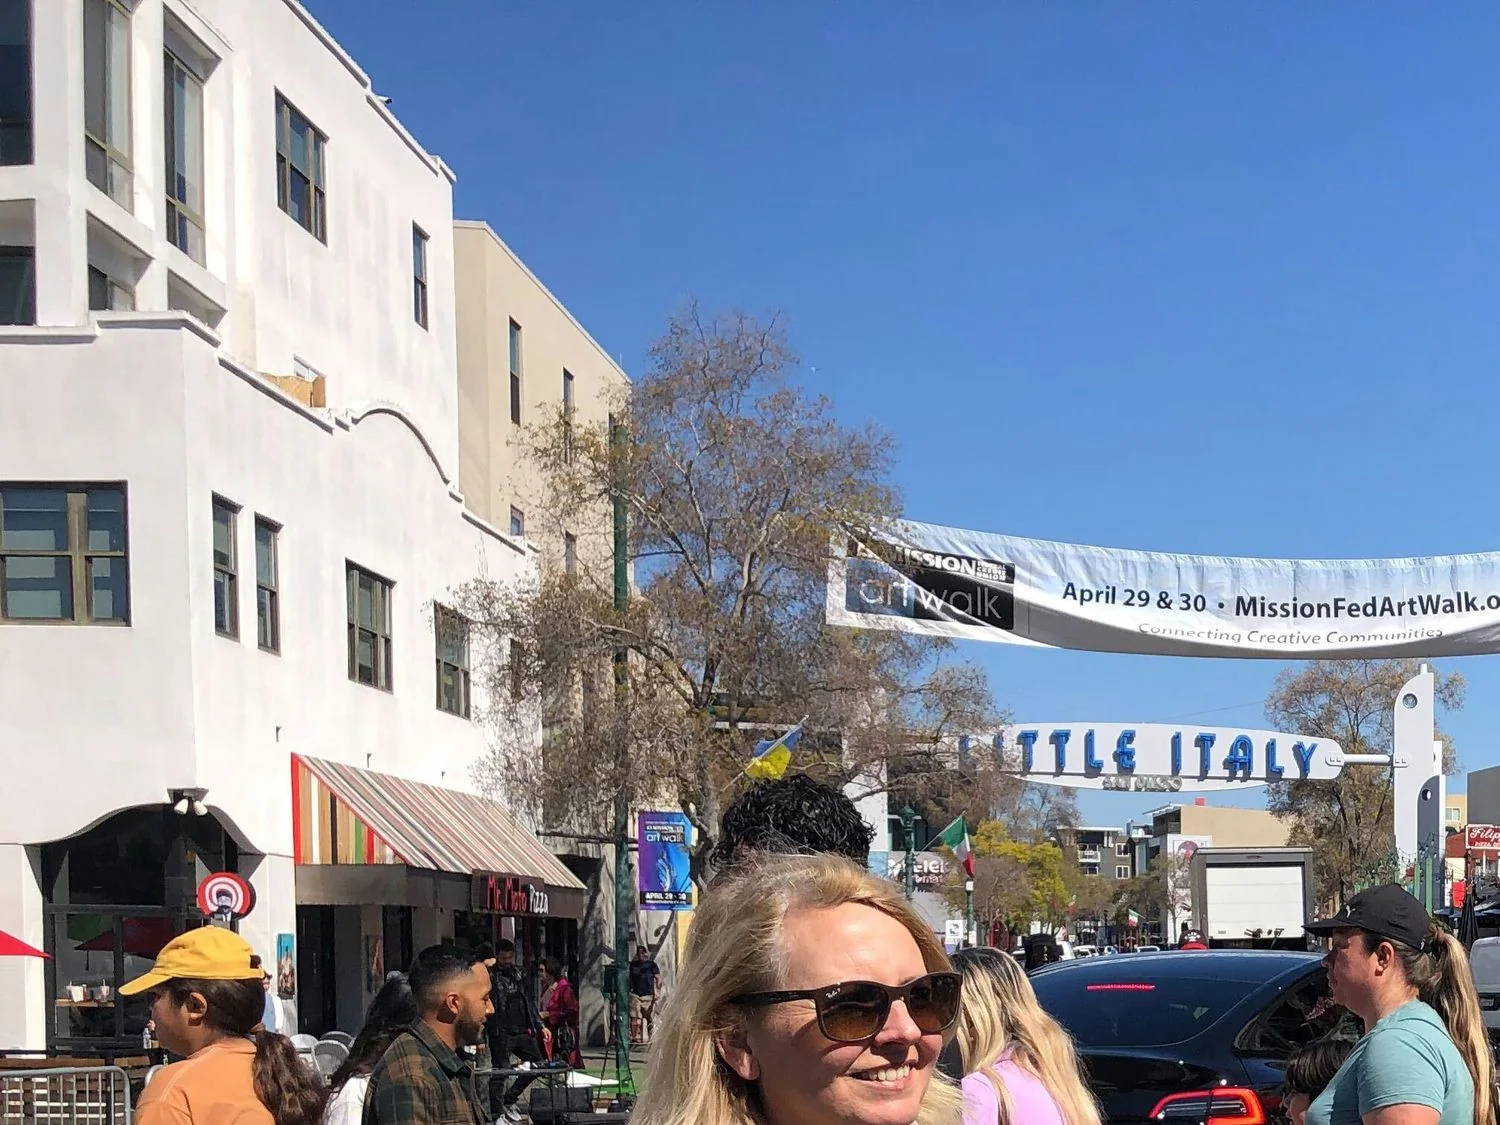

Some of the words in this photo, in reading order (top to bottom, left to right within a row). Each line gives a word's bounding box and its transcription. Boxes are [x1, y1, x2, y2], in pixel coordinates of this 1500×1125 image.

[1062, 582, 1117, 605] April
[1123, 588, 1150, 607] 29
[1156, 591, 1173, 610] &
[1179, 593, 1206, 612] 30
[1138, 623, 1242, 644] Connecting
[1247, 630, 1321, 645] Creative
[1326, 628, 1443, 644] Communities
[1171, 731, 1317, 780] ITALY
[645, 891, 664, 900] APRIL
